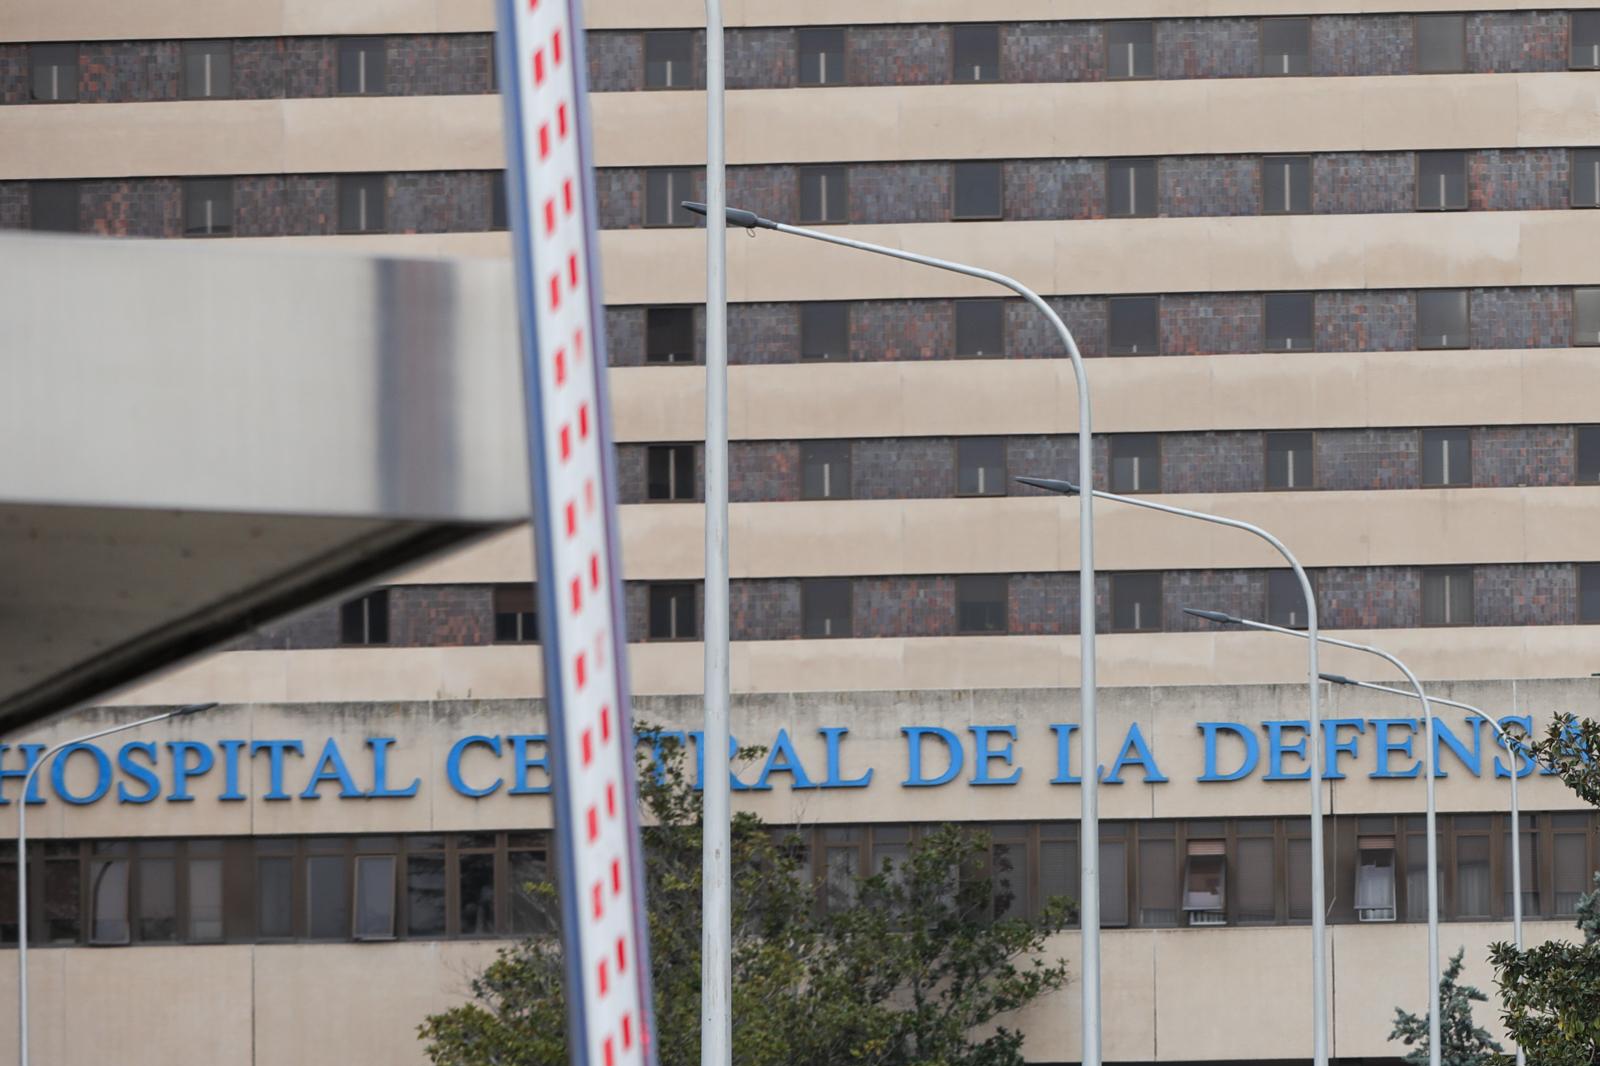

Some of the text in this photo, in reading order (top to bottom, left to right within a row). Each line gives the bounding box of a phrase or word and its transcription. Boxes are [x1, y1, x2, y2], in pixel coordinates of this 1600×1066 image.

[0, 737, 421, 805] HOSPITAL
[447, 727, 874, 796] CETRAL
[901, 724, 1023, 786] DE
[1049, 721, 1169, 785] LA
